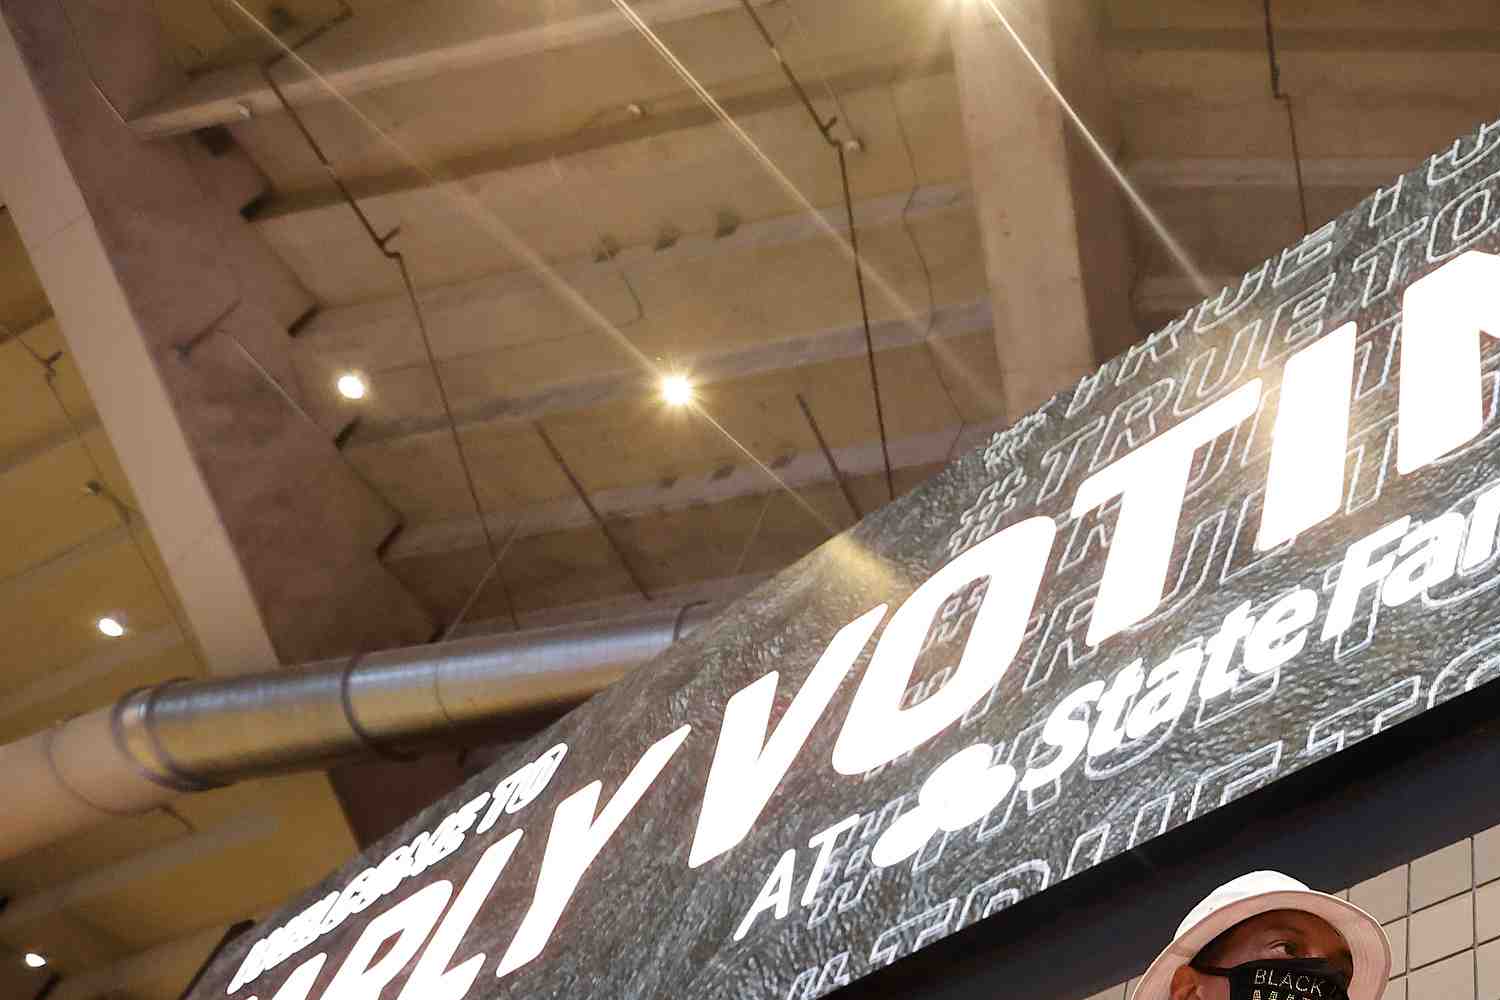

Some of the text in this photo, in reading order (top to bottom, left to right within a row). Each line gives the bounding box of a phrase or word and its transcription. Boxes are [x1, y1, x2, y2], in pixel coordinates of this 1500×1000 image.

[476, 743, 569, 834] TO
[733, 813, 860, 942] AT
[1254, 968, 1324, 997] BLACK
